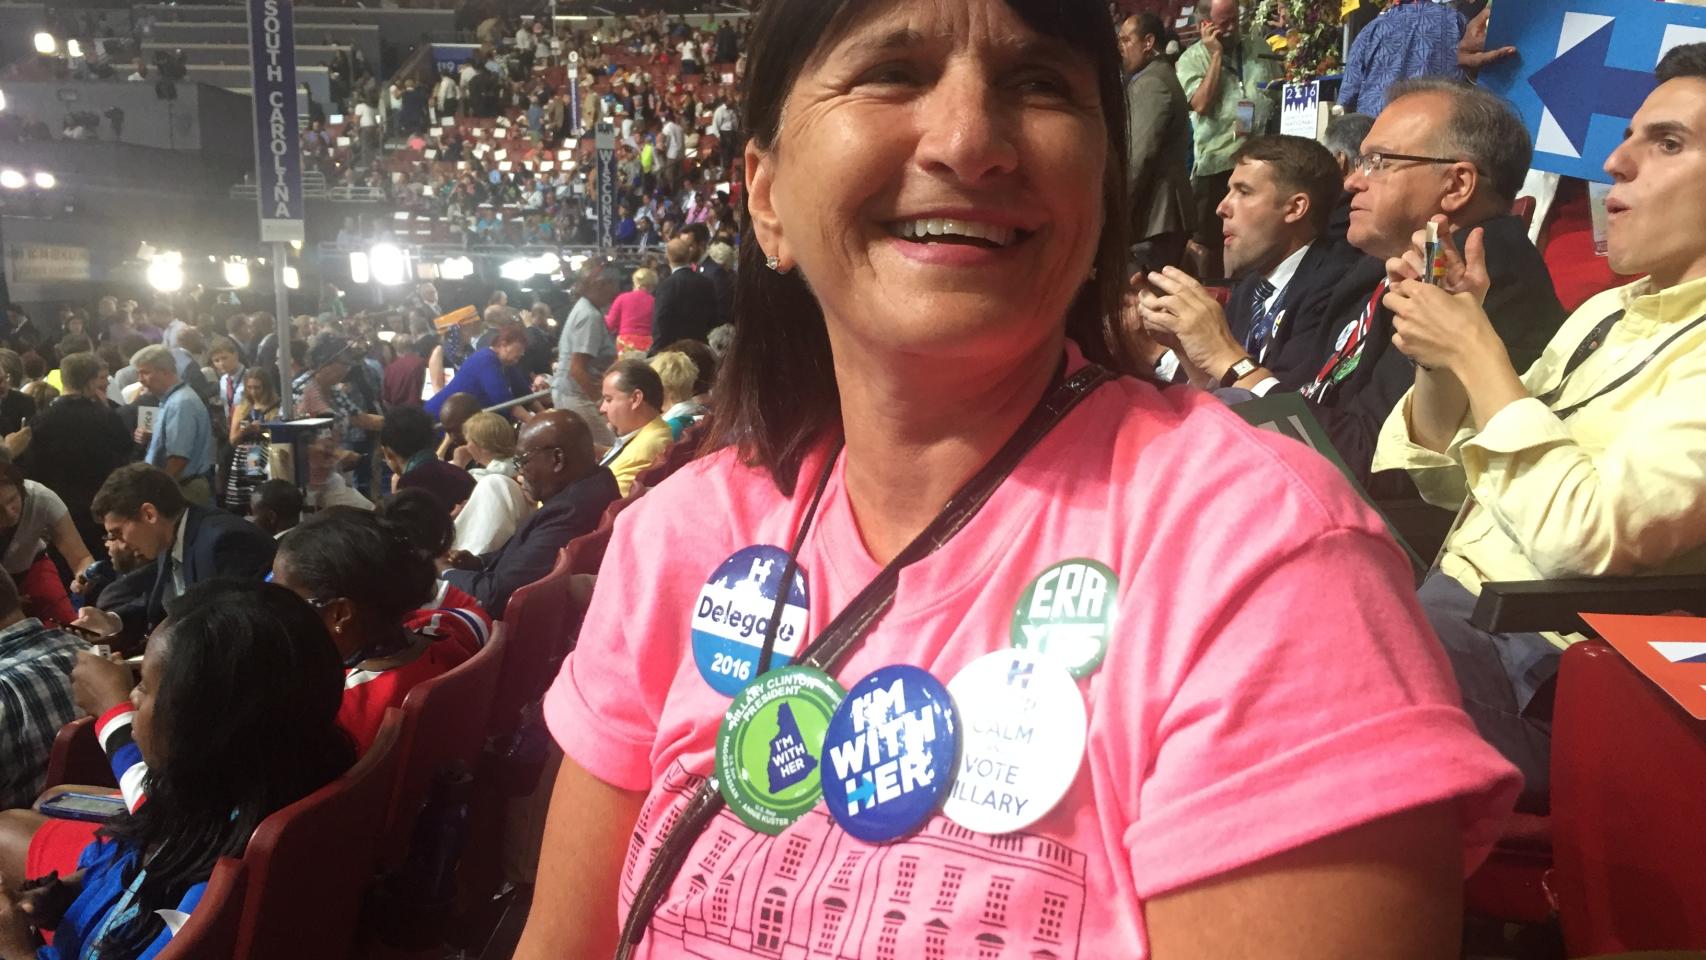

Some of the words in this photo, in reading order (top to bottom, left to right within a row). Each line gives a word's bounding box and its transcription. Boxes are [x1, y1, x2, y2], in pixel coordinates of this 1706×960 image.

[263, 0, 283, 82] SOUTH
[1286, 86, 1316, 100] 216
[269, 91, 291, 218] CAROLINA
[599, 149, 613, 247] WISCONSIN
[1028, 564, 1108, 619] ERA
[698, 595, 795, 642] Delegae
[711, 653, 752, 681] 2016
[728, 683, 764, 731] HILLARY
[766, 673, 816, 690] CLINTON
[742, 685, 801, 722] PRESIDENT
[851, 678, 906, 734] I'M
[774, 734, 794, 752] I'M
[829, 704, 937, 781] WITH
[972, 720, 1035, 745] CALM
[771, 742, 806, 767] WITH
[780, 757, 806, 778] HER
[965, 753, 1020, 785] VOTE
[951, 781, 1029, 817] ILLARY
